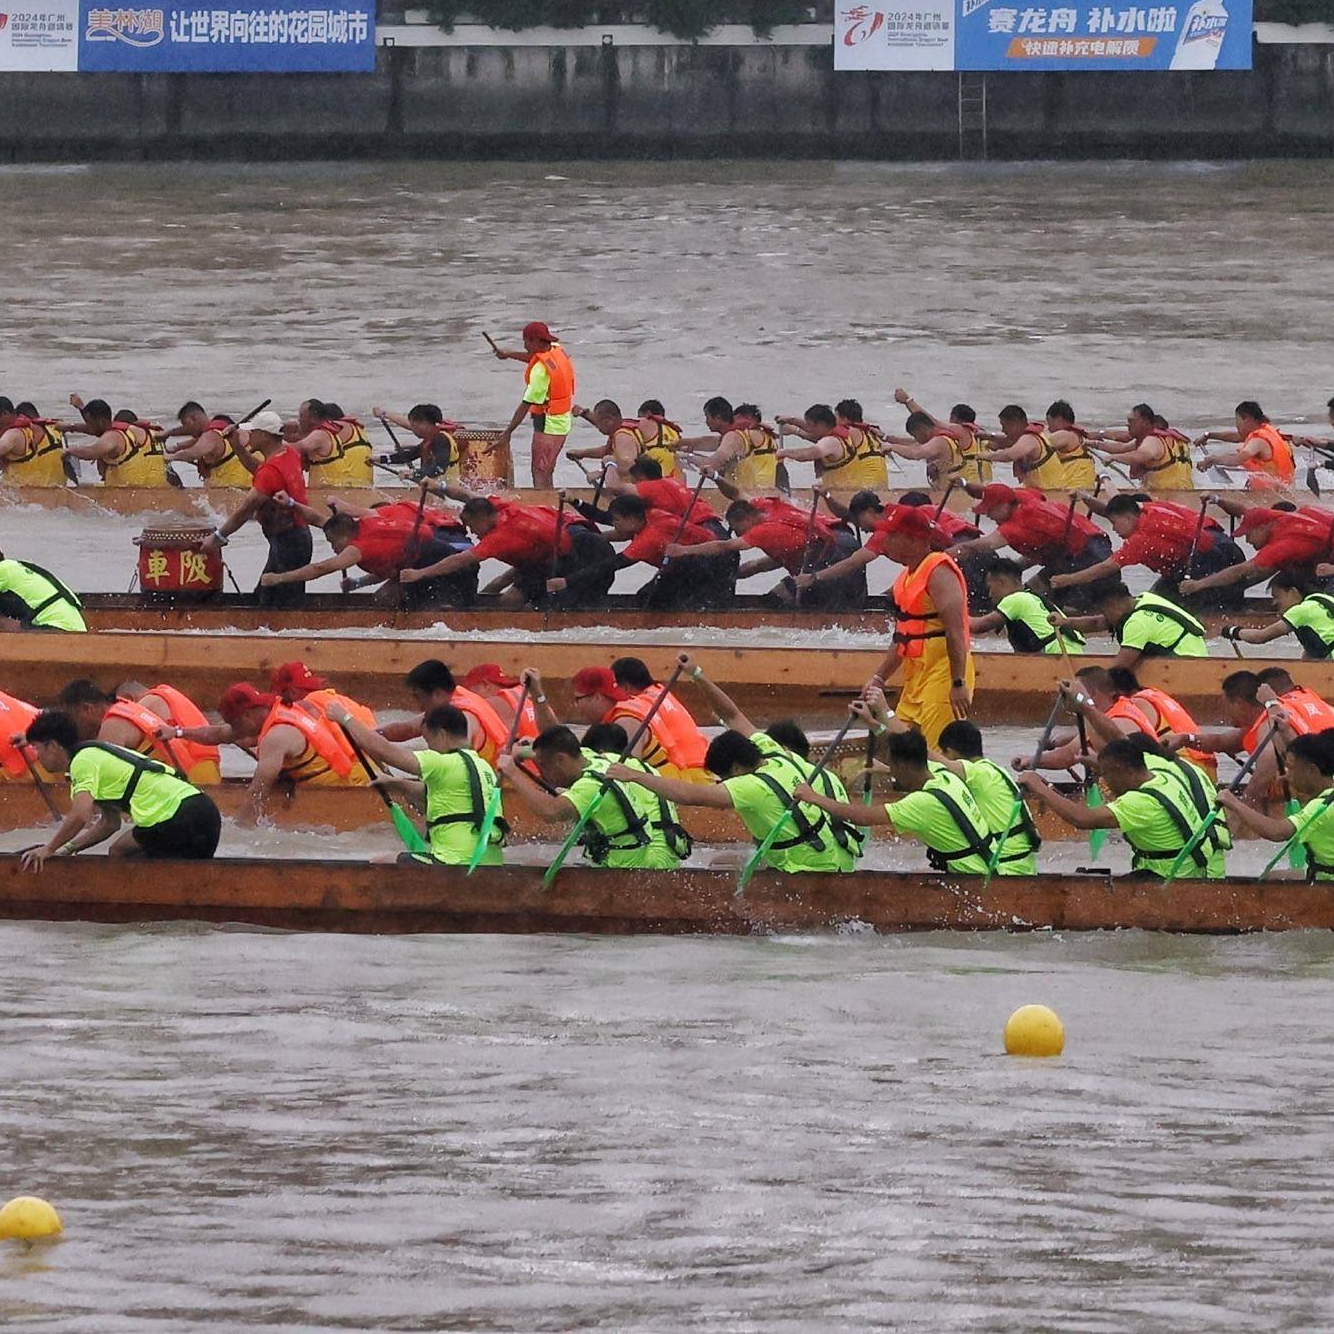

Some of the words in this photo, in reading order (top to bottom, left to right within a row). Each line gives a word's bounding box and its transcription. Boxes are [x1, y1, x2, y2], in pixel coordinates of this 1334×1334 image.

[11, 13, 65, 22] 2024年广州
[170, 9, 368, 44] 让世界向往的花园城市
[887, 12, 941, 21] 2024年广州
[988, 7, 1078, 34] 赛龙舟
[1087, 6, 1178, 33] 补水啦
[1023, 39, 1140, 56] 快速补充电解质
[145, 549, 212, 587] 車陂
